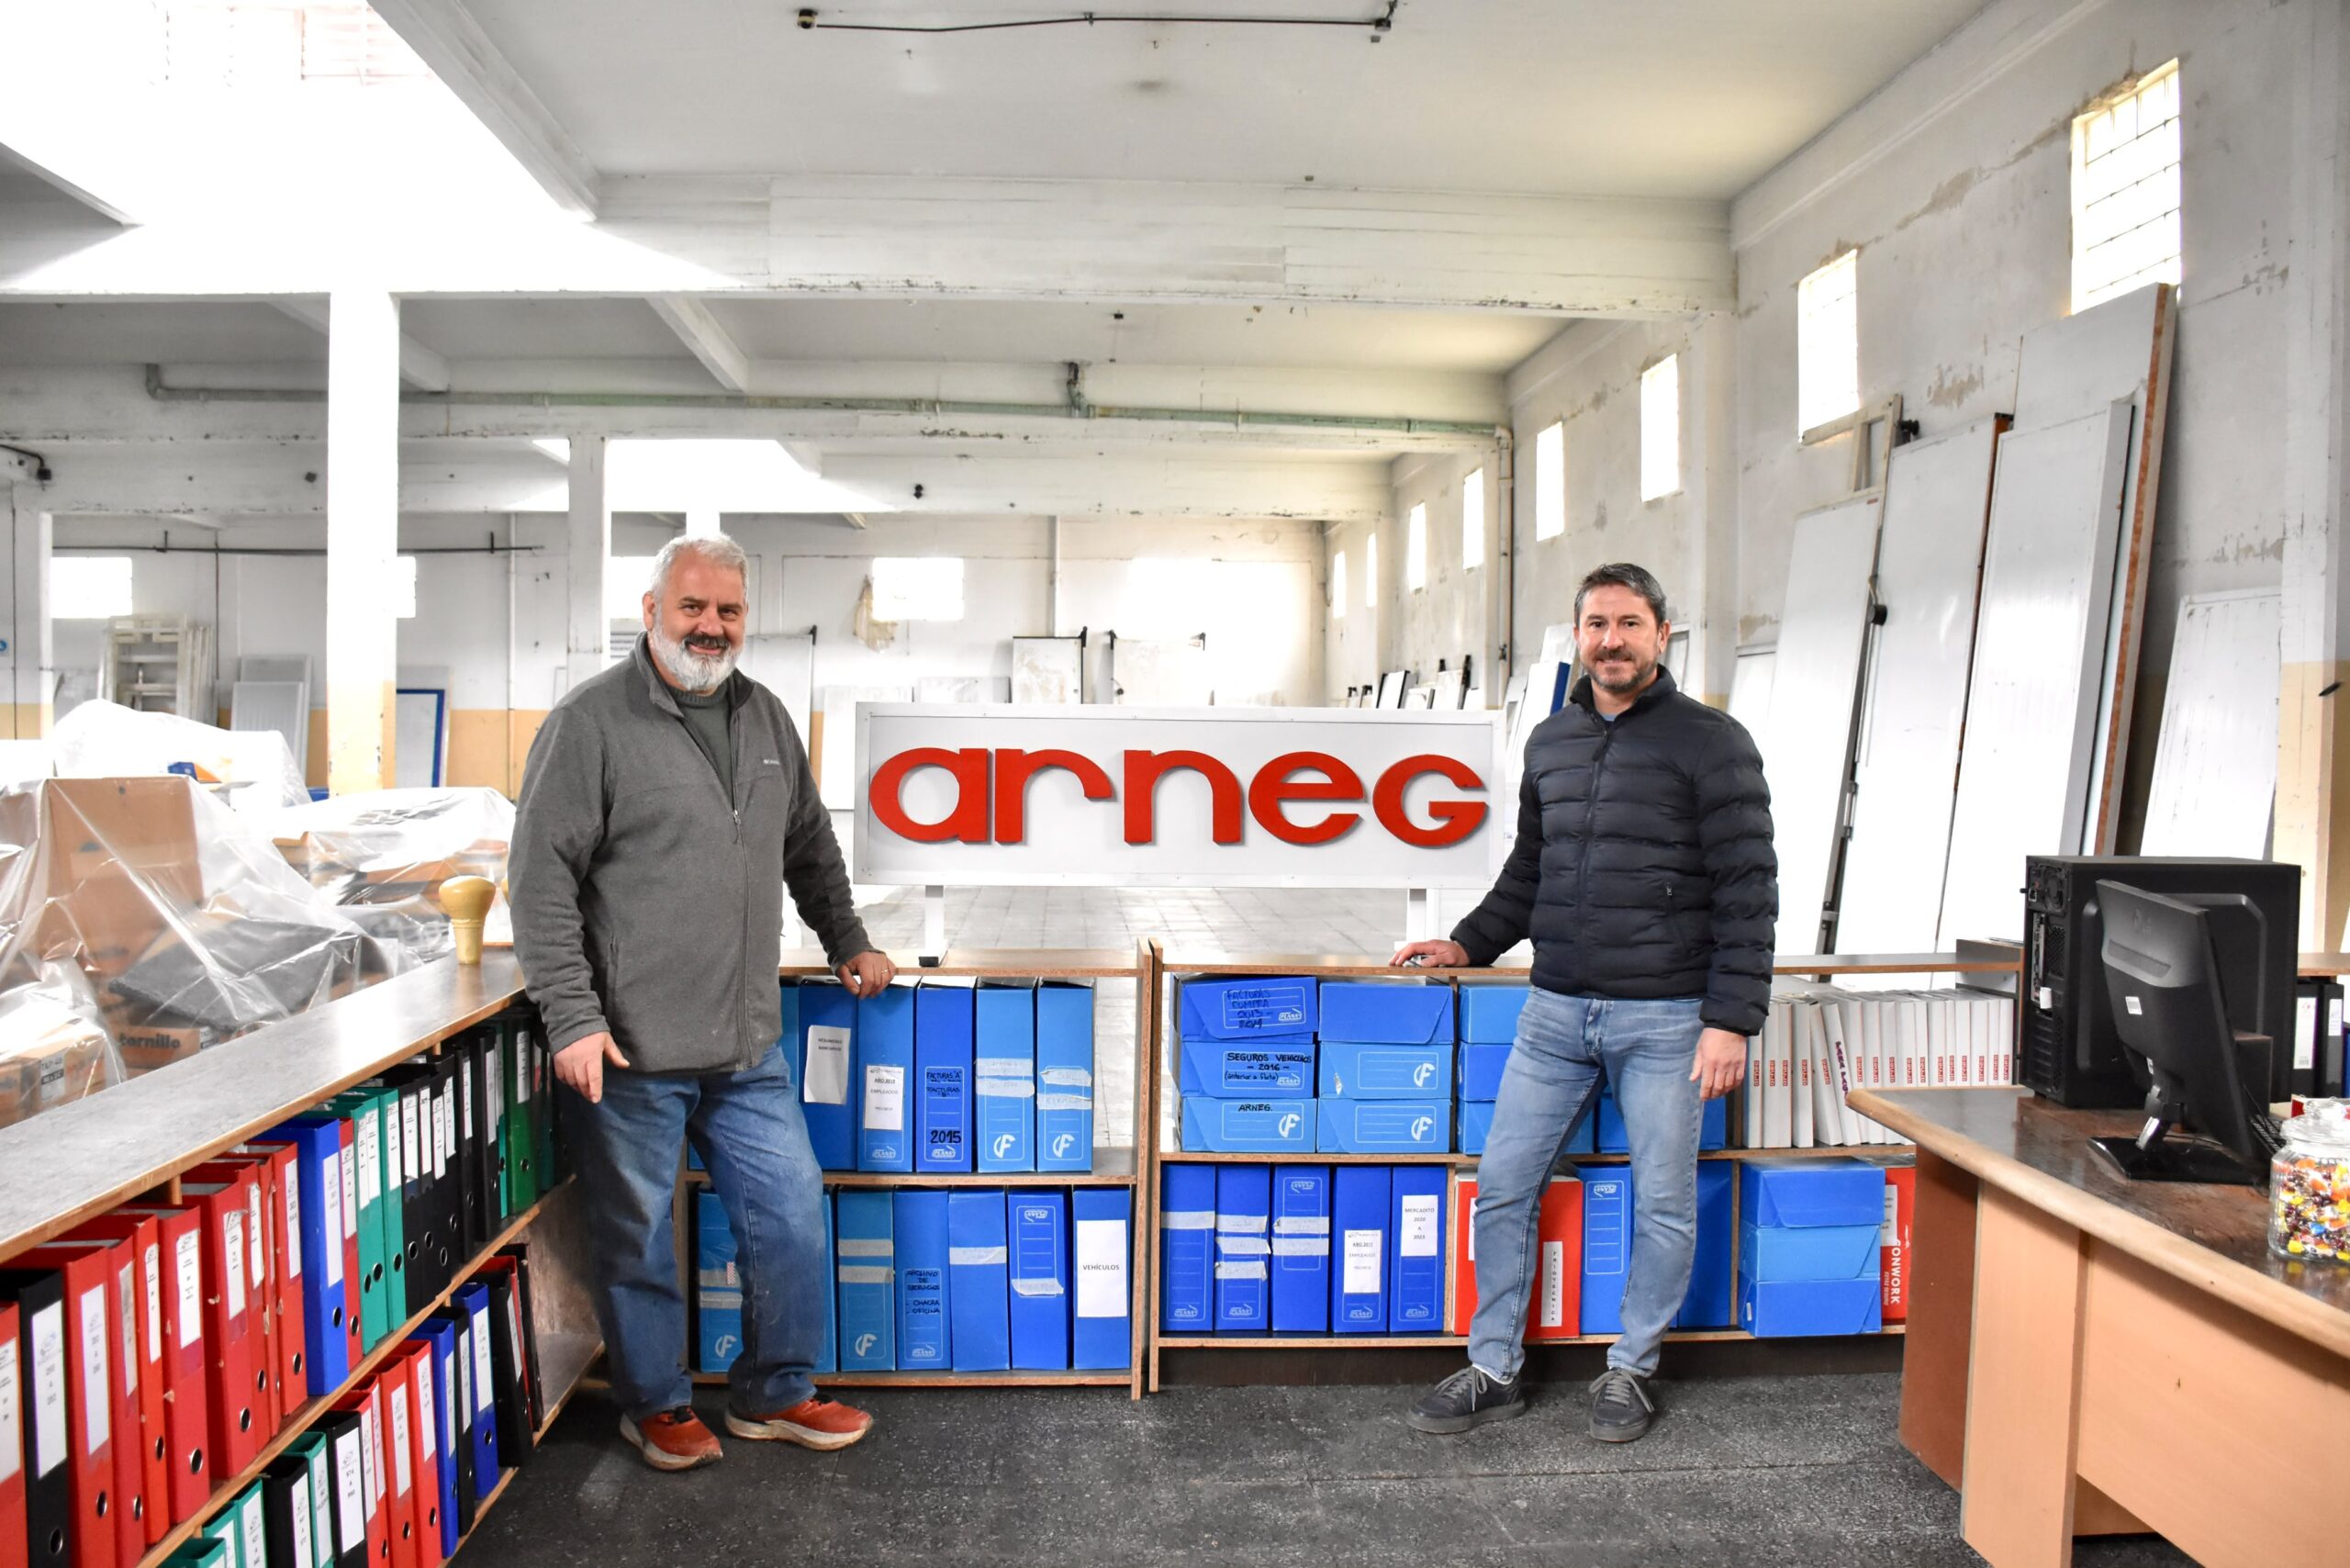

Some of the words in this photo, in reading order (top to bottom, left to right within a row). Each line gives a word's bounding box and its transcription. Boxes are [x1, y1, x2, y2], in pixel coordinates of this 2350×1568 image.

[1226, 1052, 1269, 1062] SEGUROS
[926, 1071, 953, 1080] FACTURAS
[930, 1130, 962, 1144] 2015
